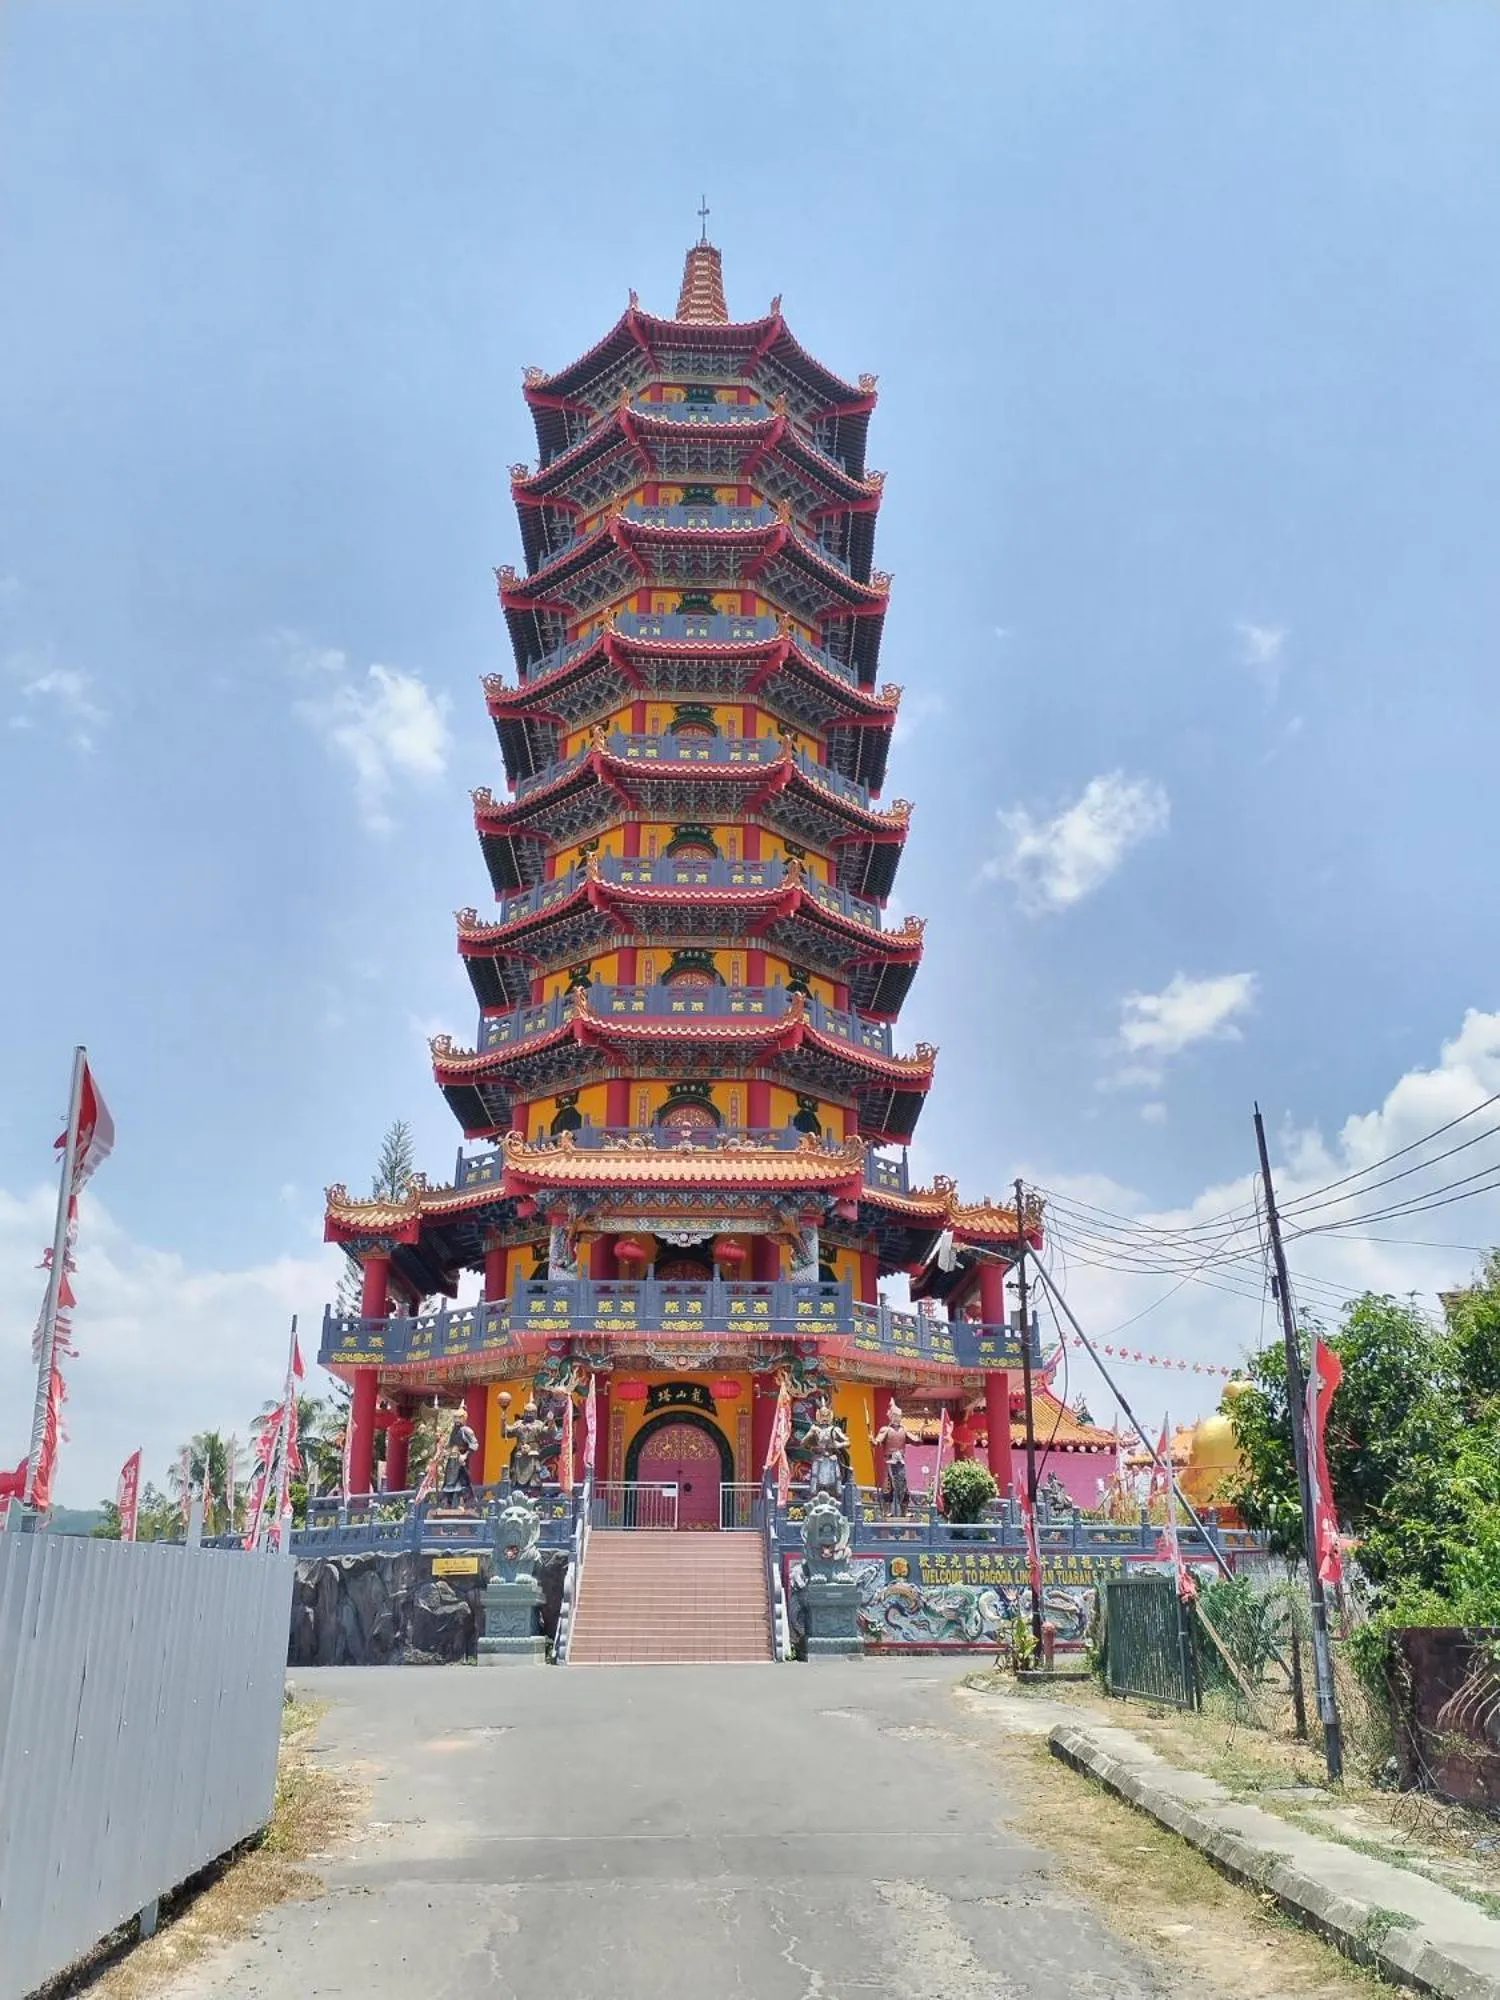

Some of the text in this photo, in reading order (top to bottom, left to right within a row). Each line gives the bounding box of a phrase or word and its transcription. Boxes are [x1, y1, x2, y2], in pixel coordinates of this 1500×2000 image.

[922, 1568, 963, 1584] WELCOME
[965, 1568, 978, 1584] TO
[979, 1569, 1012, 1585] PAGODA
[1055, 1570, 1092, 1585] TUARAN
